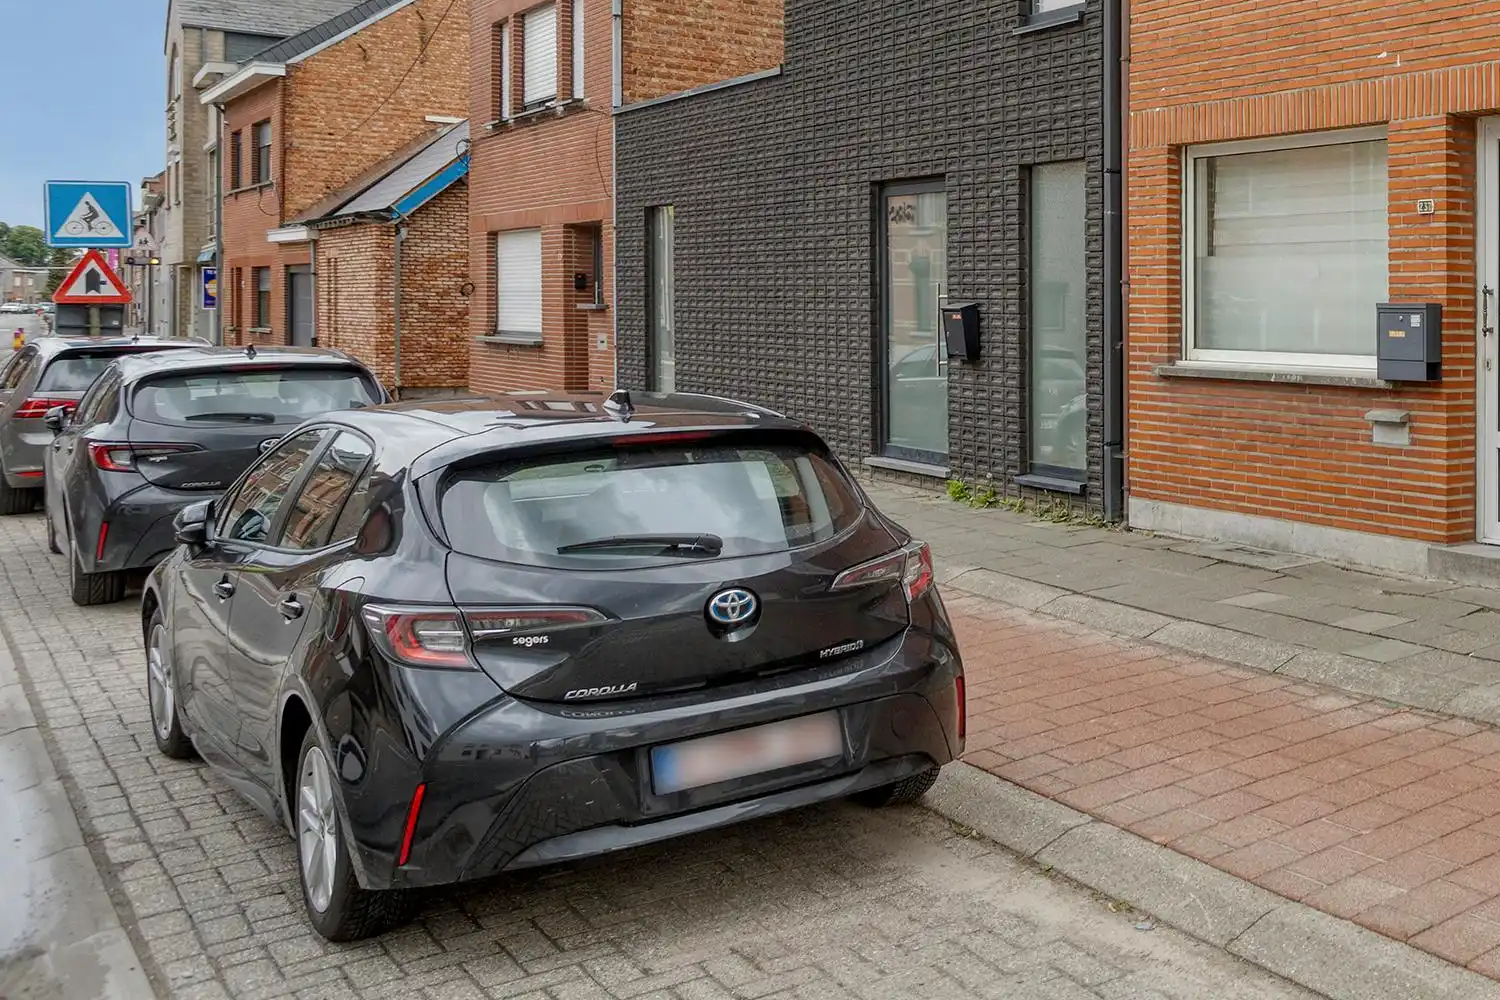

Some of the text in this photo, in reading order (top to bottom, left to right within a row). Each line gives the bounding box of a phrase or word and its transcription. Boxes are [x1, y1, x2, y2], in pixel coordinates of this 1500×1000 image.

[513, 635, 549, 647] segers
[820, 642, 856, 658] HYBRID
[564, 682, 638, 700] COROLLA
